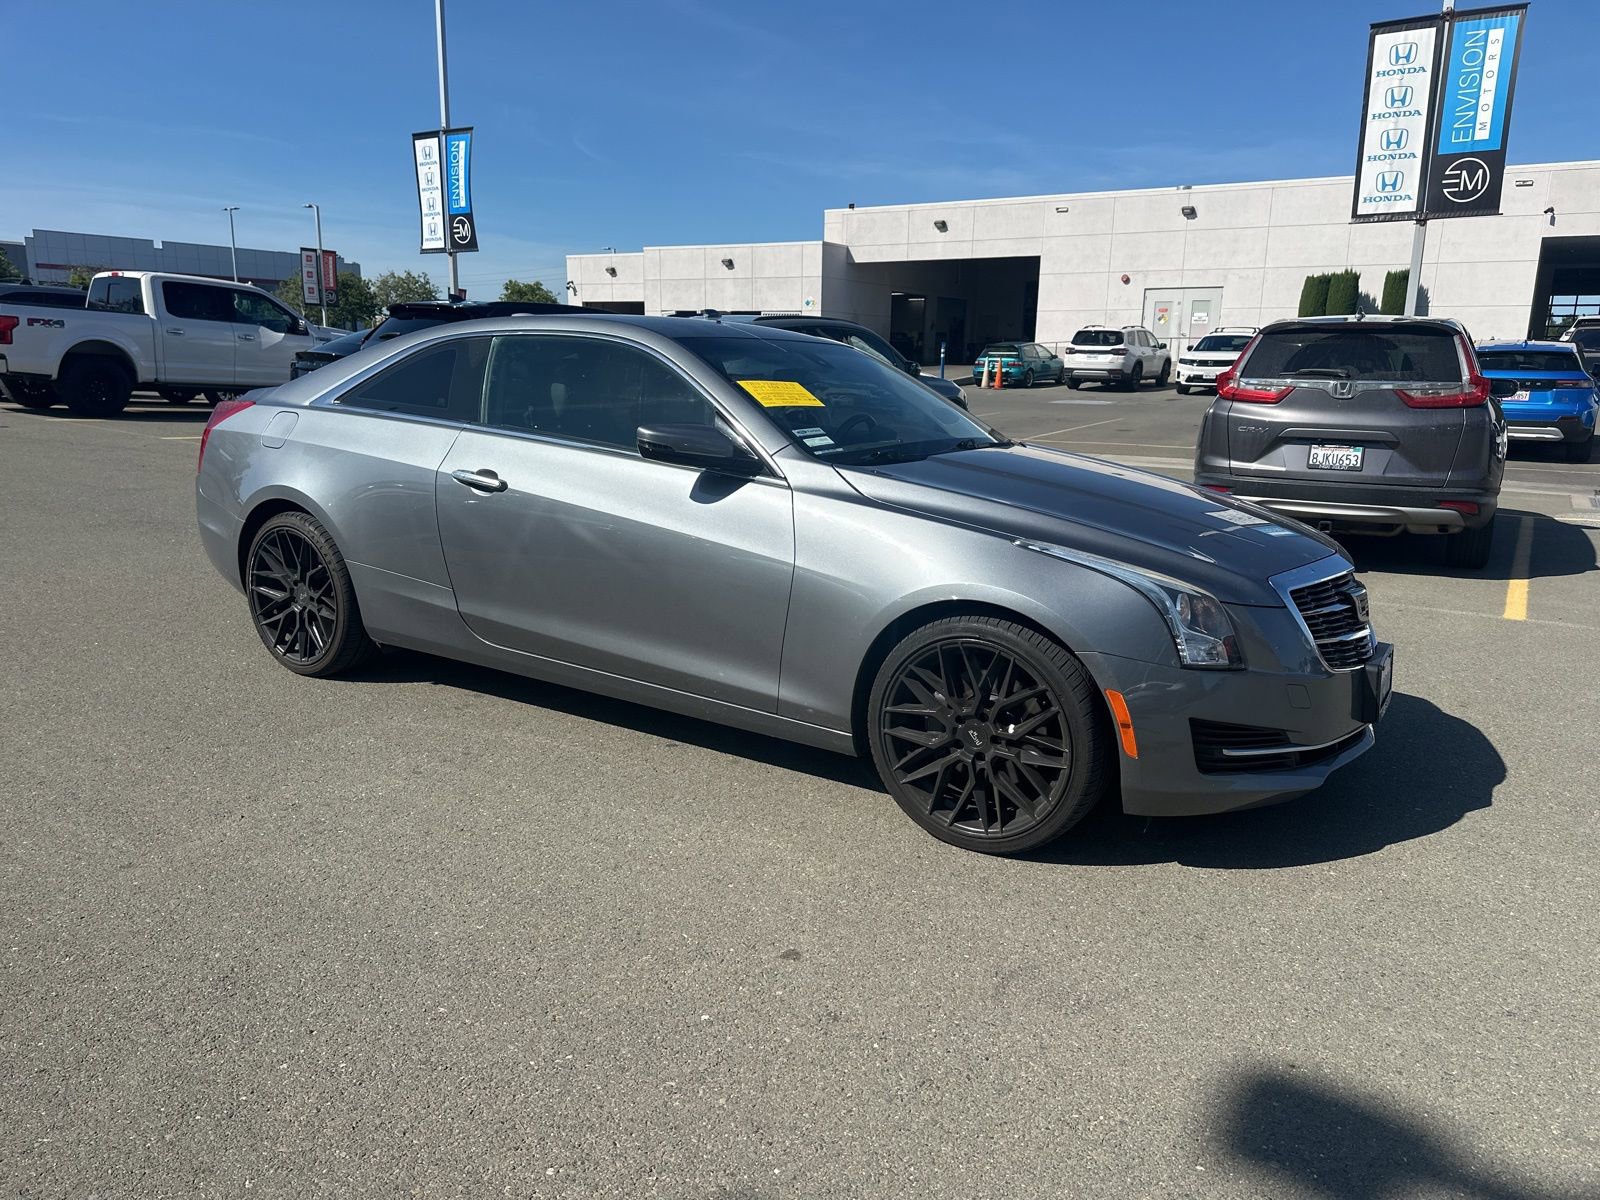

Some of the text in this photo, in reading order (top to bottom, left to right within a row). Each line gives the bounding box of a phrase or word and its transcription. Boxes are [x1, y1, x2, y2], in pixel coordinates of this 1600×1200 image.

[1375, 65, 1428, 78] HONDA
[1451, 29, 1487, 143] ENVISION
[1478, 38, 1500, 131] MOTORS
[1371, 109, 1423, 120] HONDA
[1366, 152, 1418, 162] HONDA
[450, 141, 461, 208] ENVISION
[1362, 194, 1413, 204] HONDA
[27, 317, 65, 329] FX4
[1237, 425, 1269, 433] CR-V
[1311, 452, 1360, 467] 8JKU653
